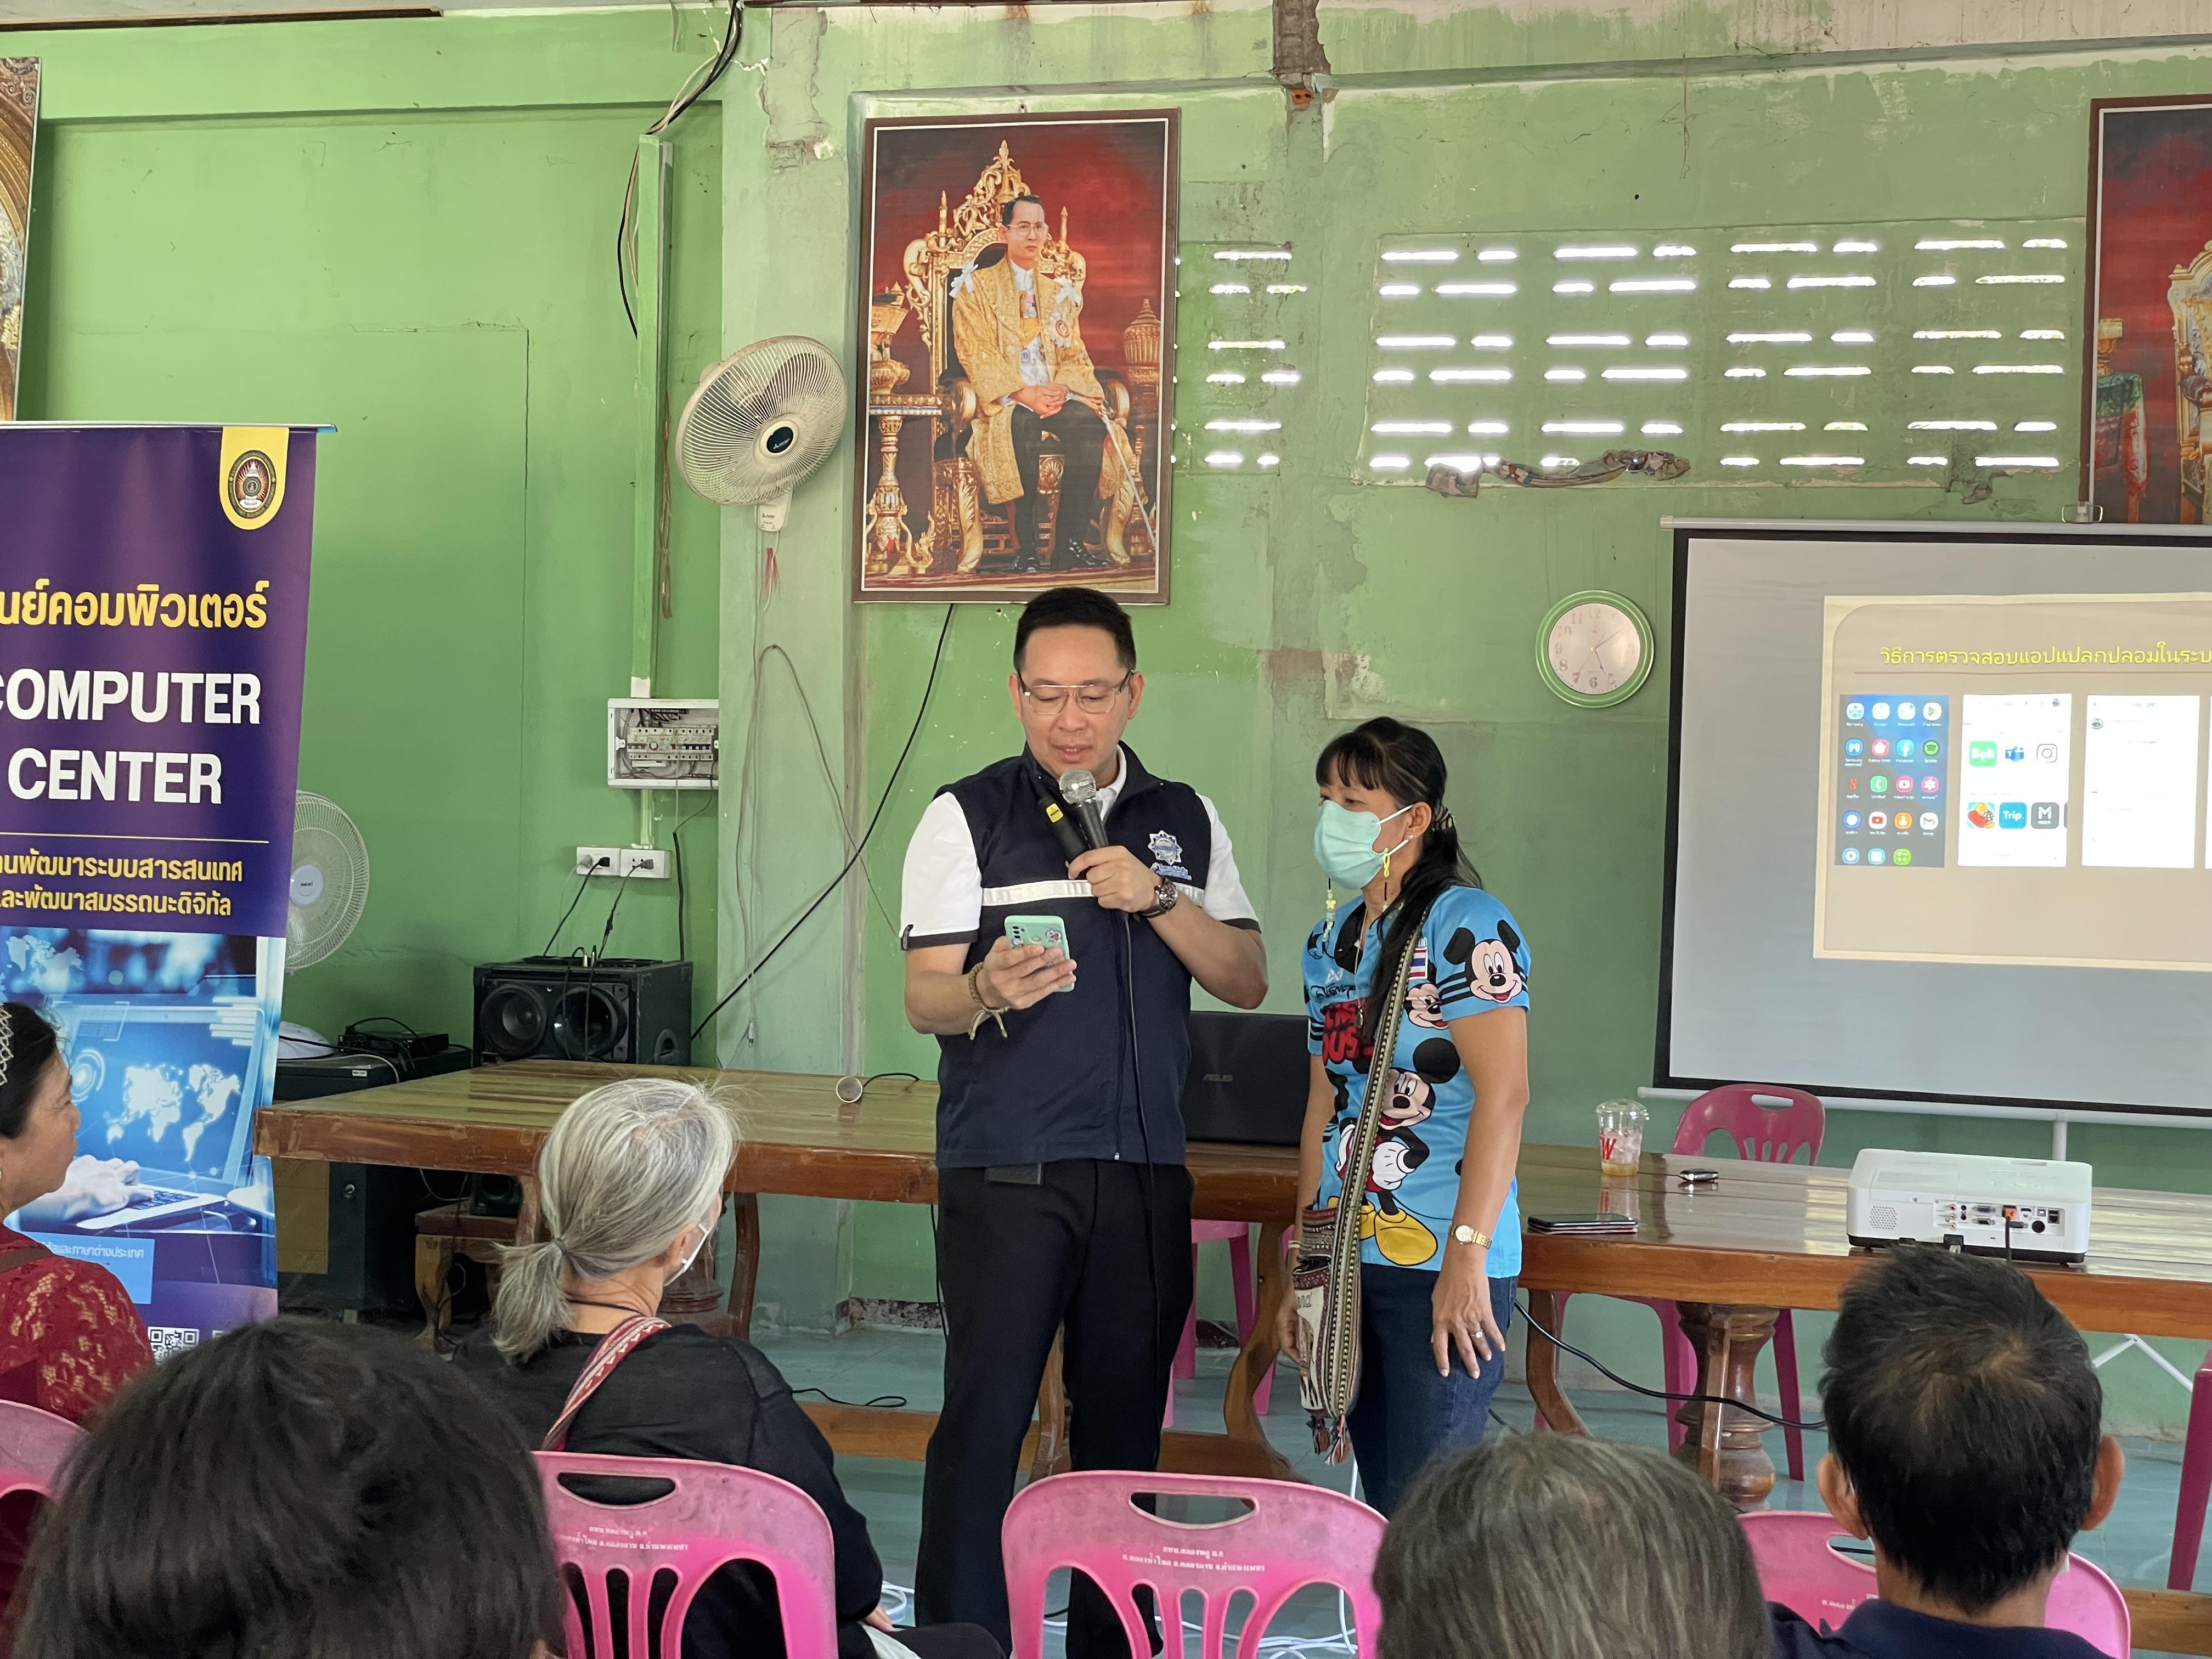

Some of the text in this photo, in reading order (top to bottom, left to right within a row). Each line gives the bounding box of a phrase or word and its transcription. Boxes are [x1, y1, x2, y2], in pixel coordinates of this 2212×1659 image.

[1559, 659, 1567, 672] 8
[1572, 672, 1581, 684] 7
[1589, 676, 1598, 689] 6
[0, 668, 261, 725] OMPUTER
[8, 747, 222, 805] CENTER
[0, 848, 242, 882] นพัฒนาระบบสารสนเทศ
[0, 884, 232, 916] ละพัฒนาสมรรถนะดิจิทัล
[1203, 1074, 1233, 1082] ASUS
